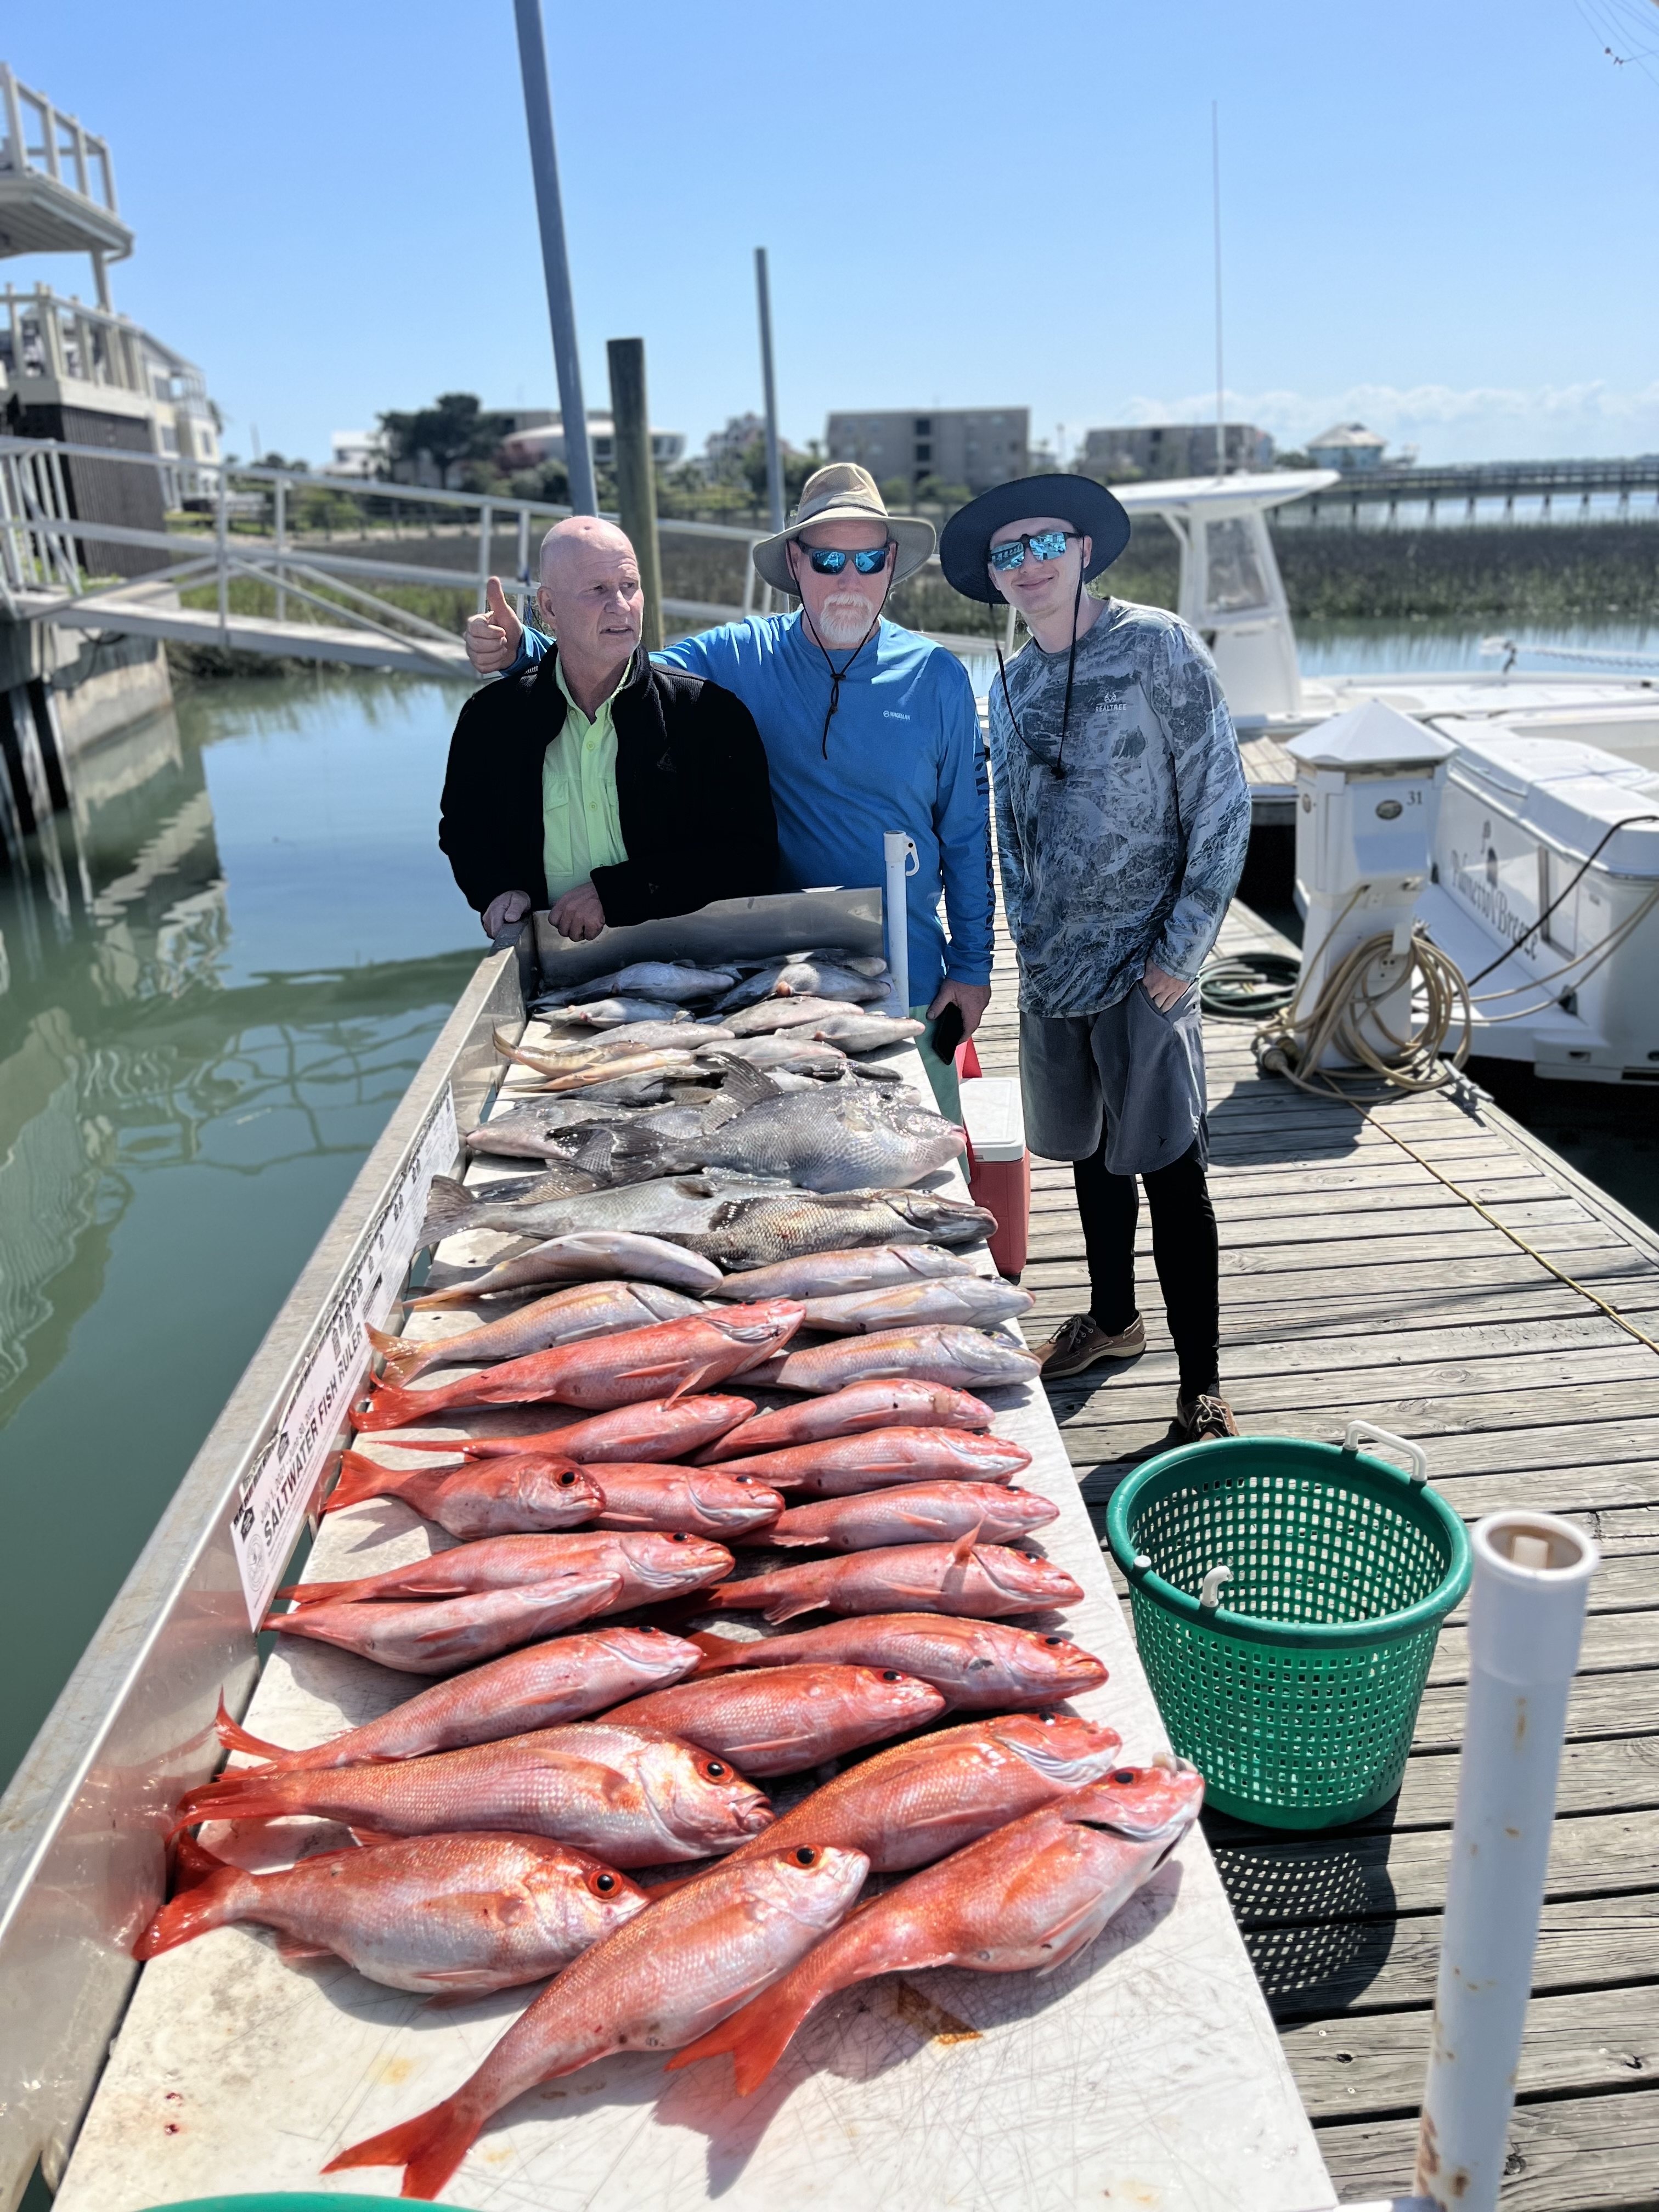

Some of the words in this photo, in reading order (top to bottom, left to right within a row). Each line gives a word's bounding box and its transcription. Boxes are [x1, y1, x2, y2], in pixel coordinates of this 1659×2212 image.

[1095, 704, 1127, 713] REALTREE
[1406, 791, 1422, 805] 31
[264, 1417, 318, 1548] SALTWATER
[318, 1375, 338, 1425] FISH
[337, 1322, 362, 1384] RULER
